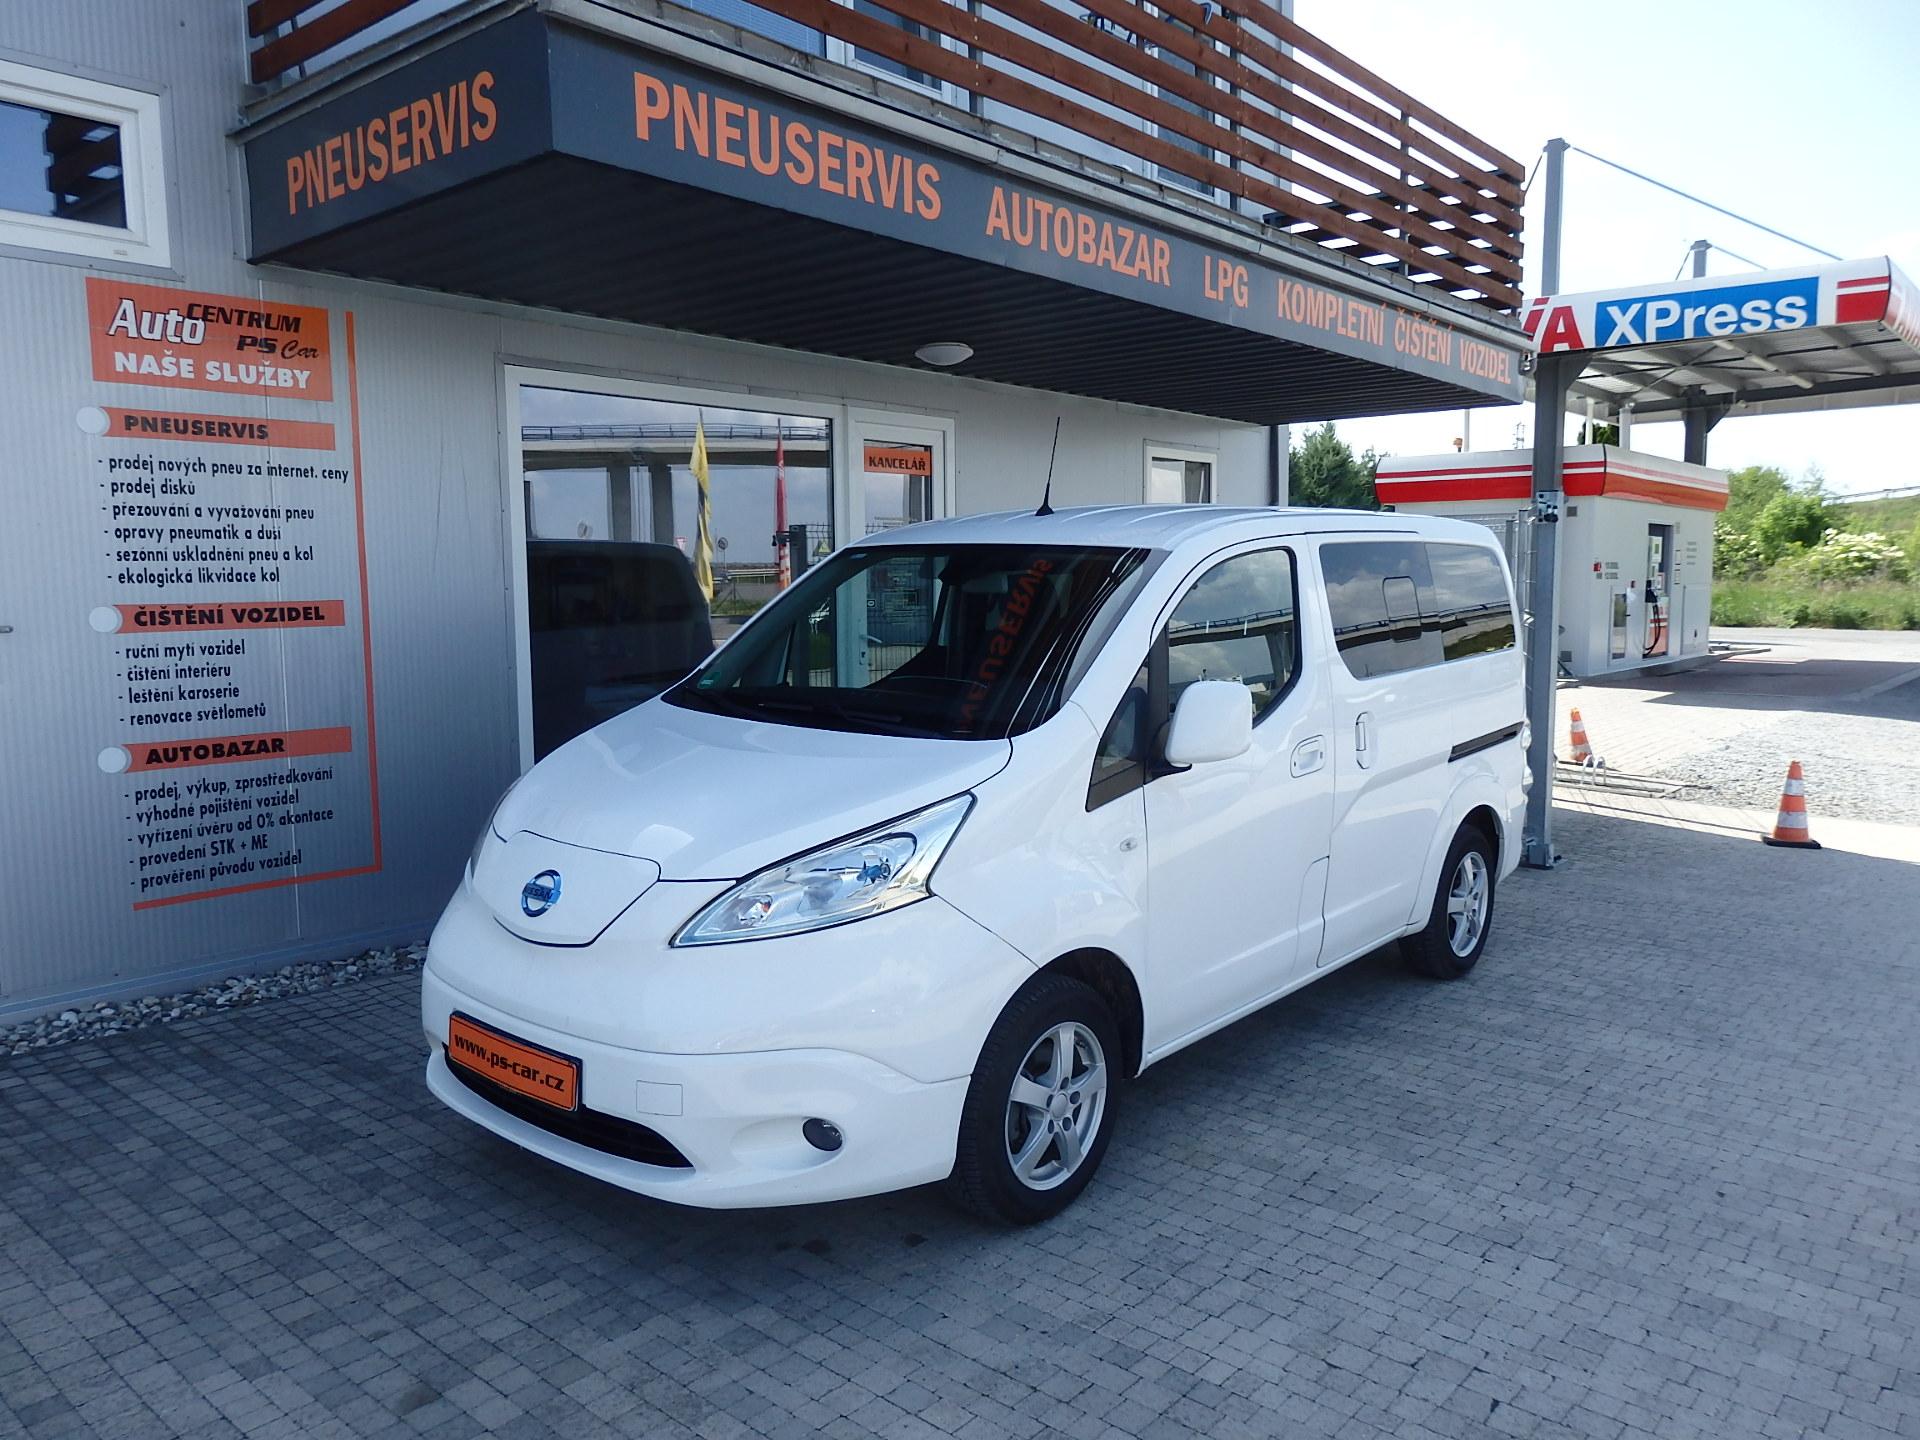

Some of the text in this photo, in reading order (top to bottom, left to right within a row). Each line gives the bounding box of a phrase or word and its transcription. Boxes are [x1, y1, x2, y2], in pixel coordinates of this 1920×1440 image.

[287, 70, 498, 216] PNEUSERVIS
[633, 71, 1512, 385] PNEUSERVIS AUTOBAZAR LPG KOMPLETNÍ ČIŠTĚNÍ VOZIDEL
[106, 298, 301, 345] Auto CENTRUM
[1605, 296, 1808, 346] XPress
[237, 335, 319, 360] PS Car
[114, 350, 311, 388] NAŠE SLUŽBY
[125, 415, 268, 439] PNEUSERVIS
[109, 455, 348, 483] prodej nových pneu za internet. ceny
[111, 479, 195, 498] prodej disků
[113, 504, 314, 522] přezouvání a vyvažování pneu
[114, 526, 164, 543] opravy
[170, 526, 238, 542] pneumatik
[245, 530, 252, 539] a
[117, 546, 313, 564] sezónní uskladnění pneu a kol
[118, 568, 280, 587] ekologická likvidace kol
[134, 604, 325, 626] ČIŠTĚNÍ VOZIDEL
[126, 644, 159, 659] ruční
[200, 639, 245, 656] vozidel
[128, 662, 231, 681] čištění interiéru
[128, 683, 239, 704] leštění karoserie
[130, 702, 266, 726] renovace světlometů
[146, 738, 285, 765] AUTOBAZAR
[135, 767, 332, 805] prodej, výkup, zprostředkování
[137, 790, 299, 826] výhodné pojištění vozidel
[138, 809, 333, 849] vyřízení úvěru od 0% akontace
[140, 834, 268, 870] provedení STK + ME
[141, 850, 302, 892] prověření původu vozidel
[454, 1033, 565, 1092] www.ps-car.cz
